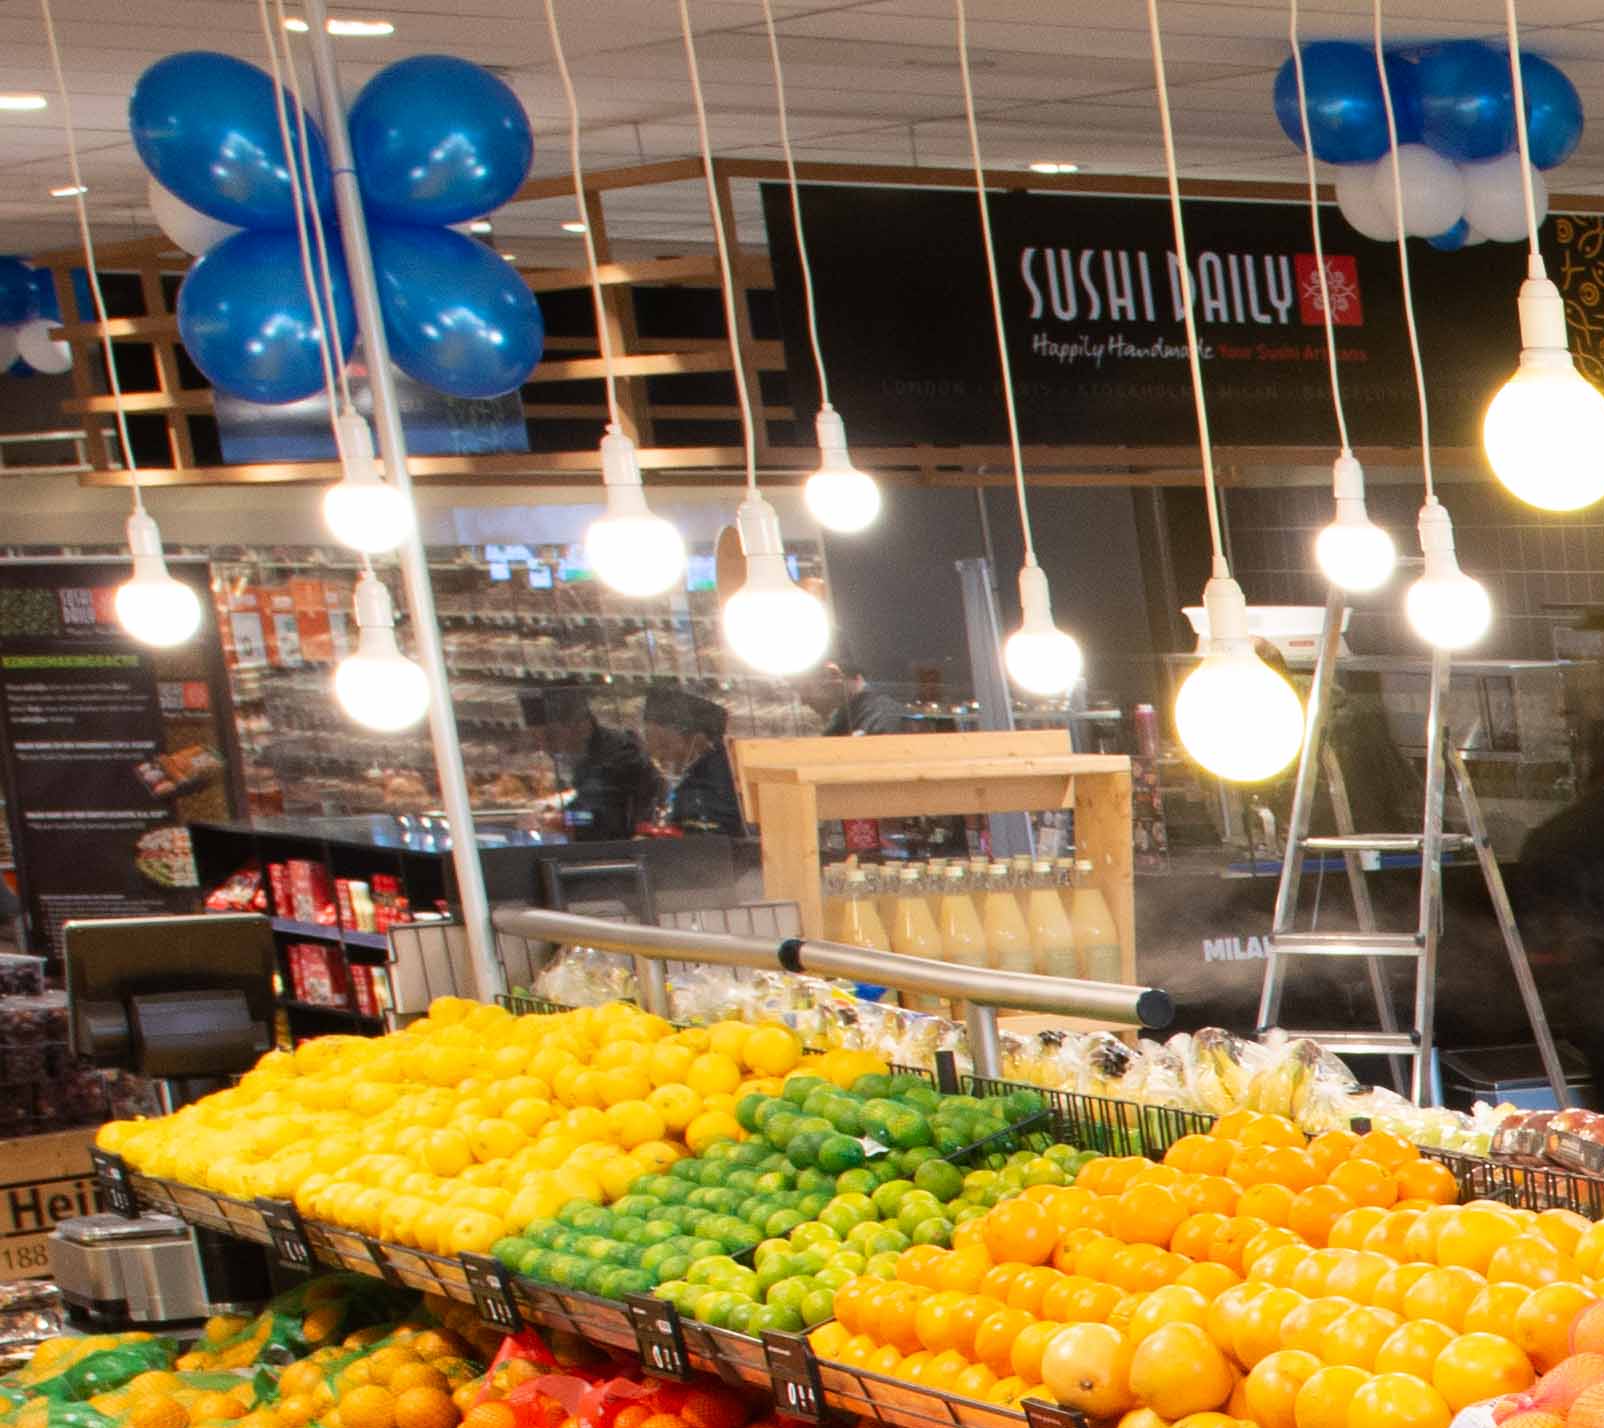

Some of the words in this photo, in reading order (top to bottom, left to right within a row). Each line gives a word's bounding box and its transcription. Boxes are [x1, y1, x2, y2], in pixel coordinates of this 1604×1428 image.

[1020, 247, 1156, 321] SUSHI
[1169, 251, 1294, 325] DAILY
[1032, 335, 1104, 364] Happily
